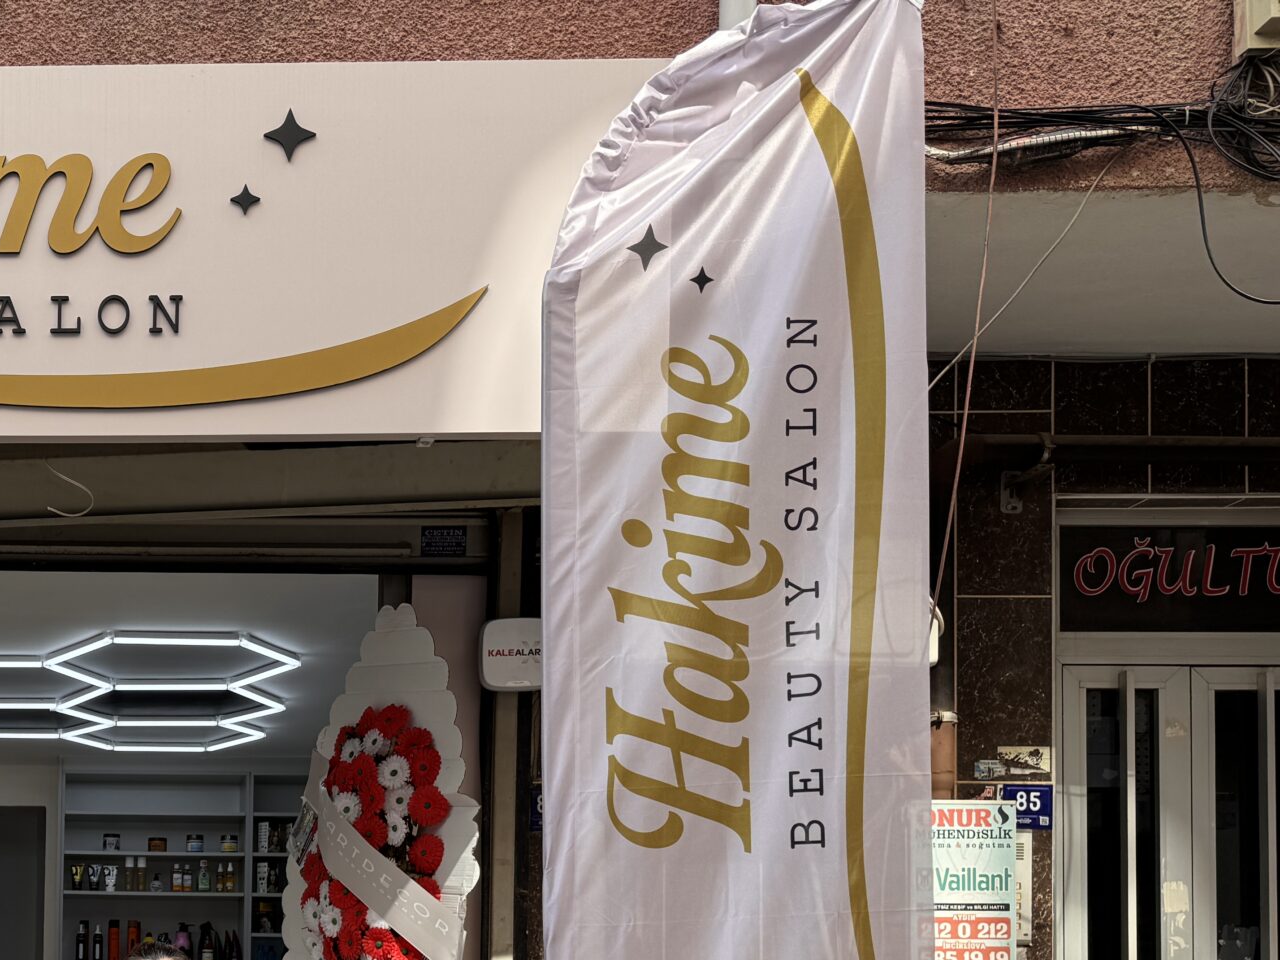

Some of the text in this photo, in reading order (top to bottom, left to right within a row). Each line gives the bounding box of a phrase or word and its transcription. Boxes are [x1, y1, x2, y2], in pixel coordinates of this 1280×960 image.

[783, 316, 826, 849] BEAUTY SALON
[606, 334, 784, 854] Hakime
[487, 648, 542, 657] KALEALAR
[1016, 790, 1041, 812] 85
[932, 841, 951, 849] tma
[935, 867, 1012, 892] Vaillant
[934, 922, 1008, 939] 12 0 212
